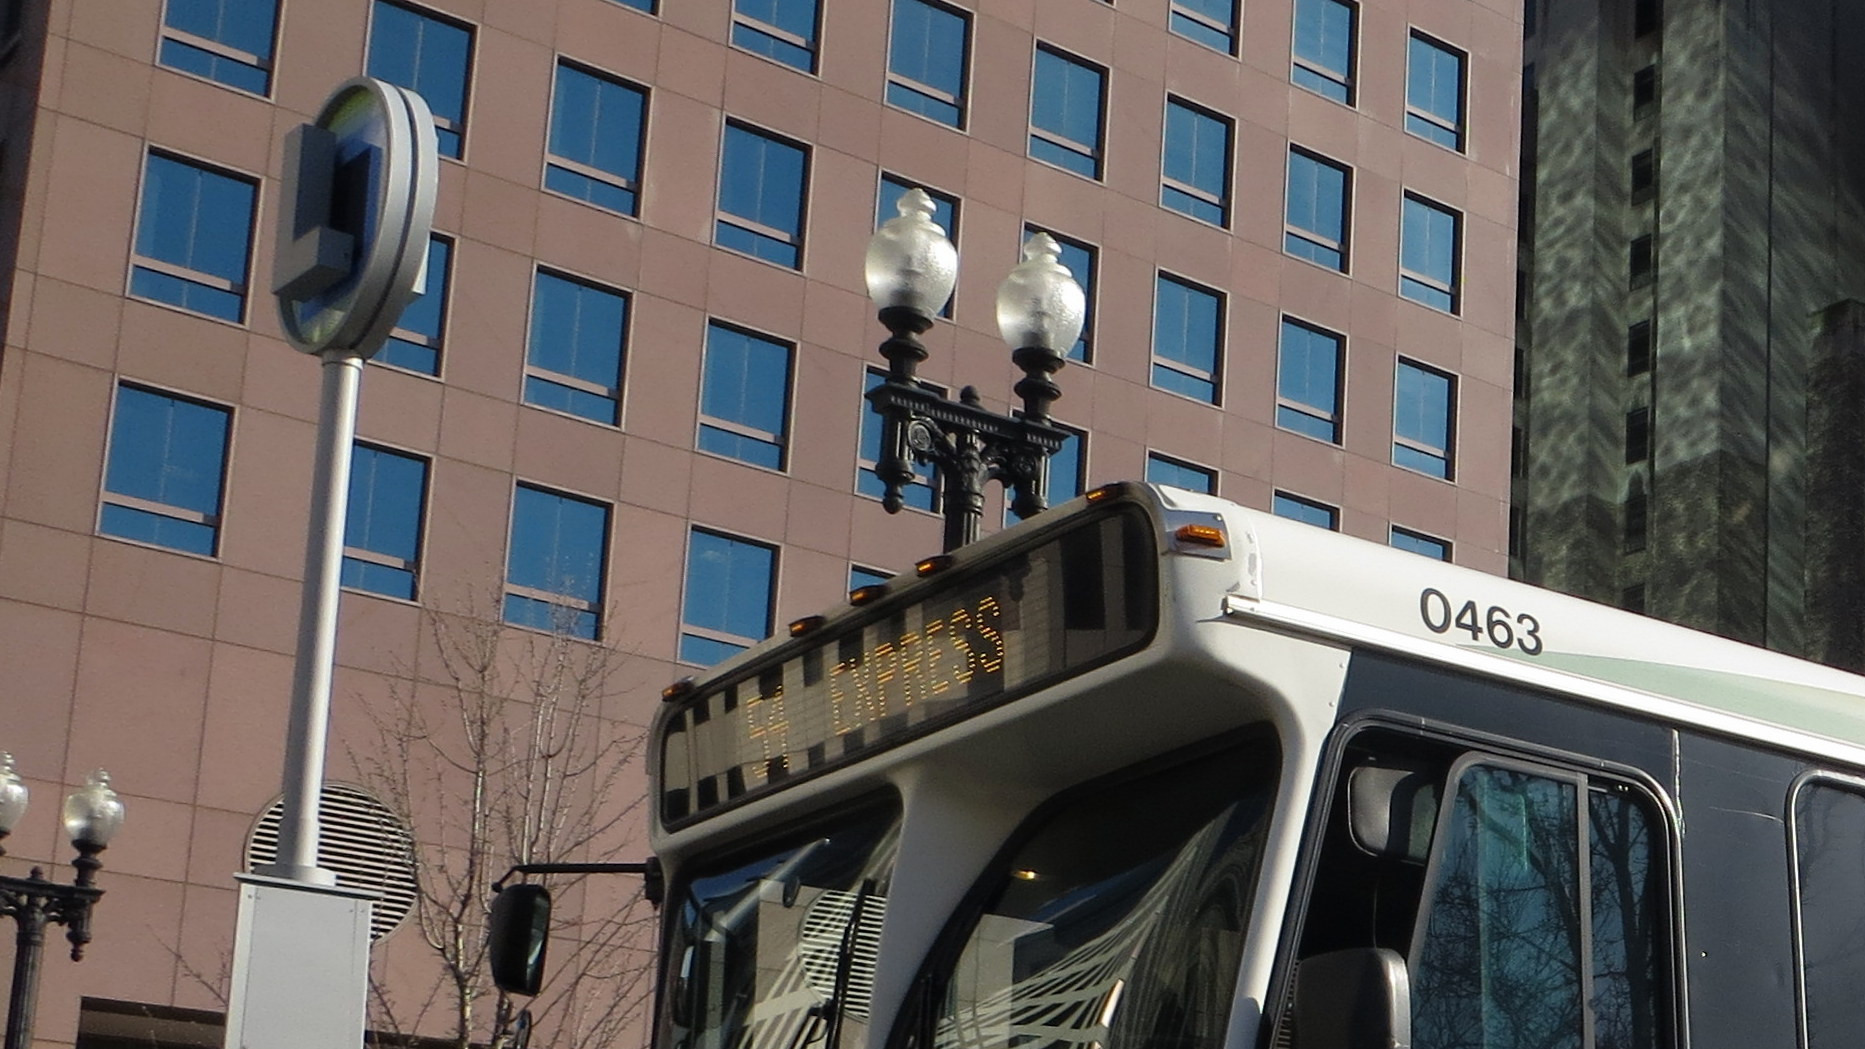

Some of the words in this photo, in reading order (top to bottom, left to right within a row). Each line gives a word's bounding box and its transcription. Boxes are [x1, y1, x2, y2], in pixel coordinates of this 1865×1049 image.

[1420, 588, 1543, 656] 0463
[747, 685, 789, 778] 54
[830, 597, 1004, 736] EXPRESS
